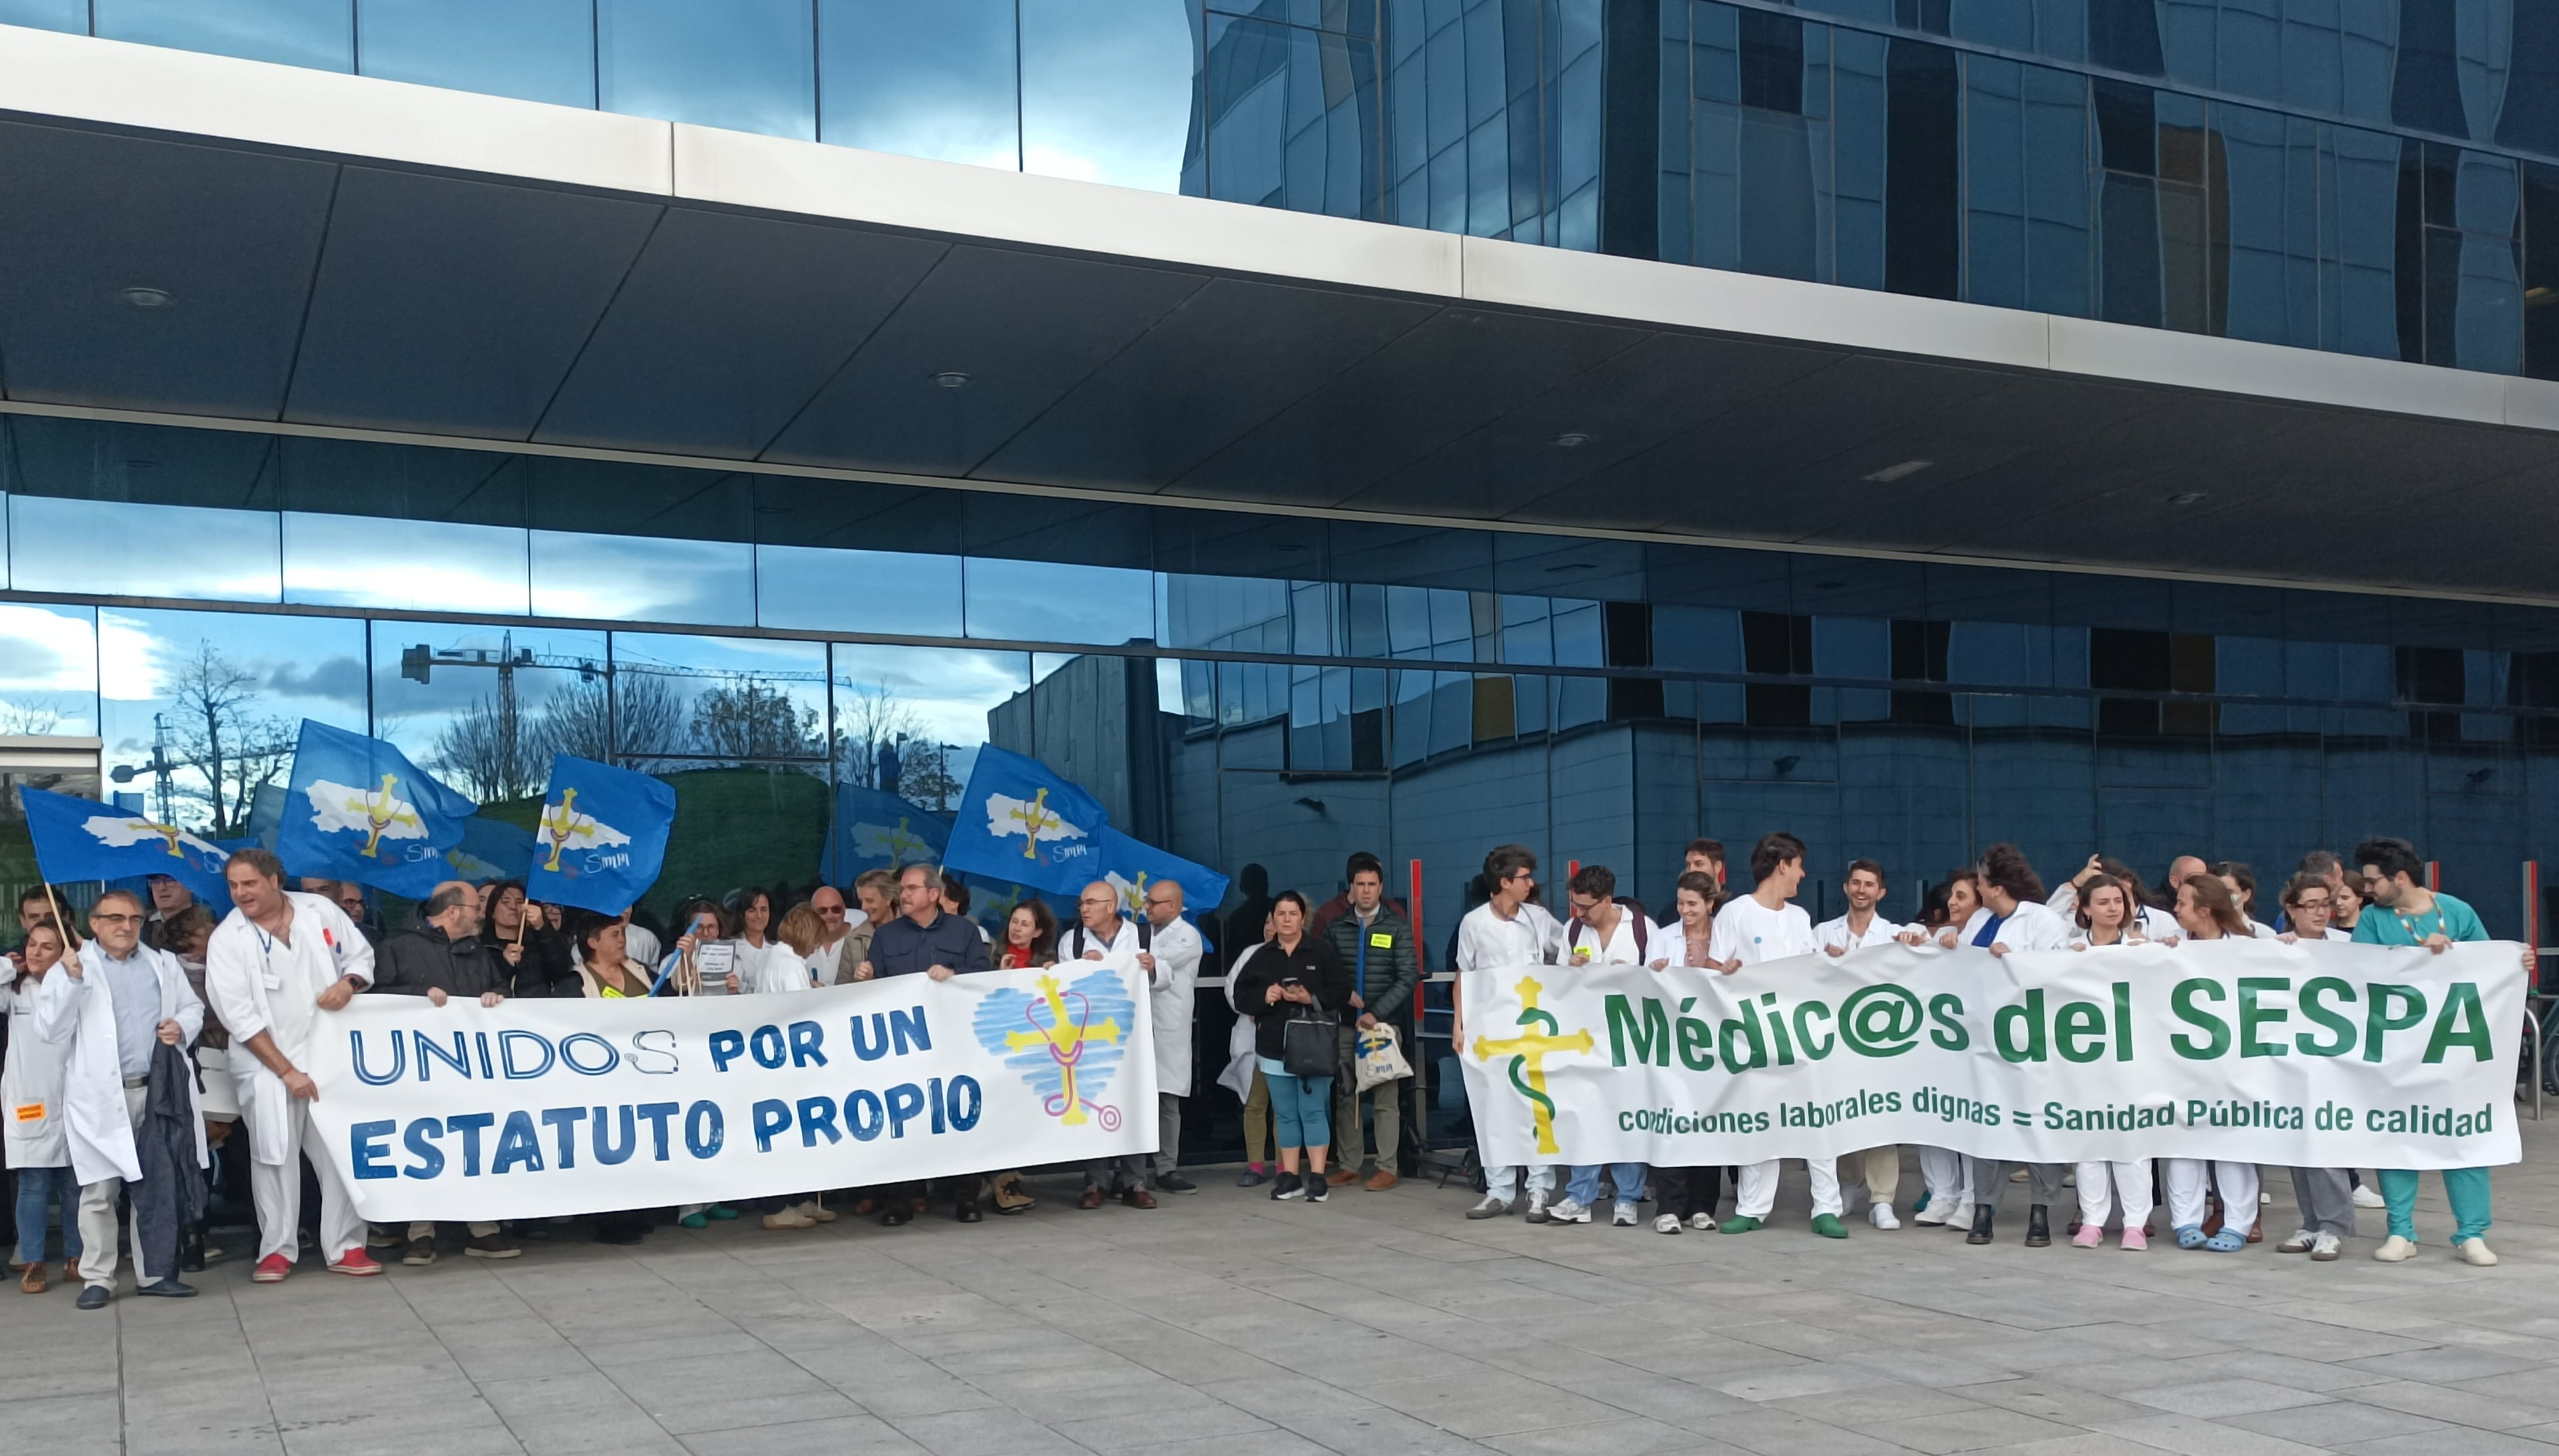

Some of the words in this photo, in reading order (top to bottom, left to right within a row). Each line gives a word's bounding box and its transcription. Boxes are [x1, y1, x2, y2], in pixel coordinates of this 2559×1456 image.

[350, 1029, 679, 1086] UNIDOS
[709, 1021, 828, 1072] POR
[850, 1005, 932, 1061] UN
[1605, 983, 1969, 1073] Médic@s
[1994, 982, 2134, 1063] del
[2171, 976, 2493, 1064] SESPA
[351, 1100, 724, 1180] ESTATUTO
[752, 1075, 982, 1153] PROPIO
[1619, 1105, 1770, 1134] condiciones
[1780, 1087, 1902, 1128] laborales
[1912, 1087, 2001, 1127] dignas
[2045, 1100, 2175, 1131] Sanidad
[2187, 1100, 2304, 1130] Pública
[2315, 1102, 2353, 1131] de
[2366, 1103, 2493, 1137] calidad
